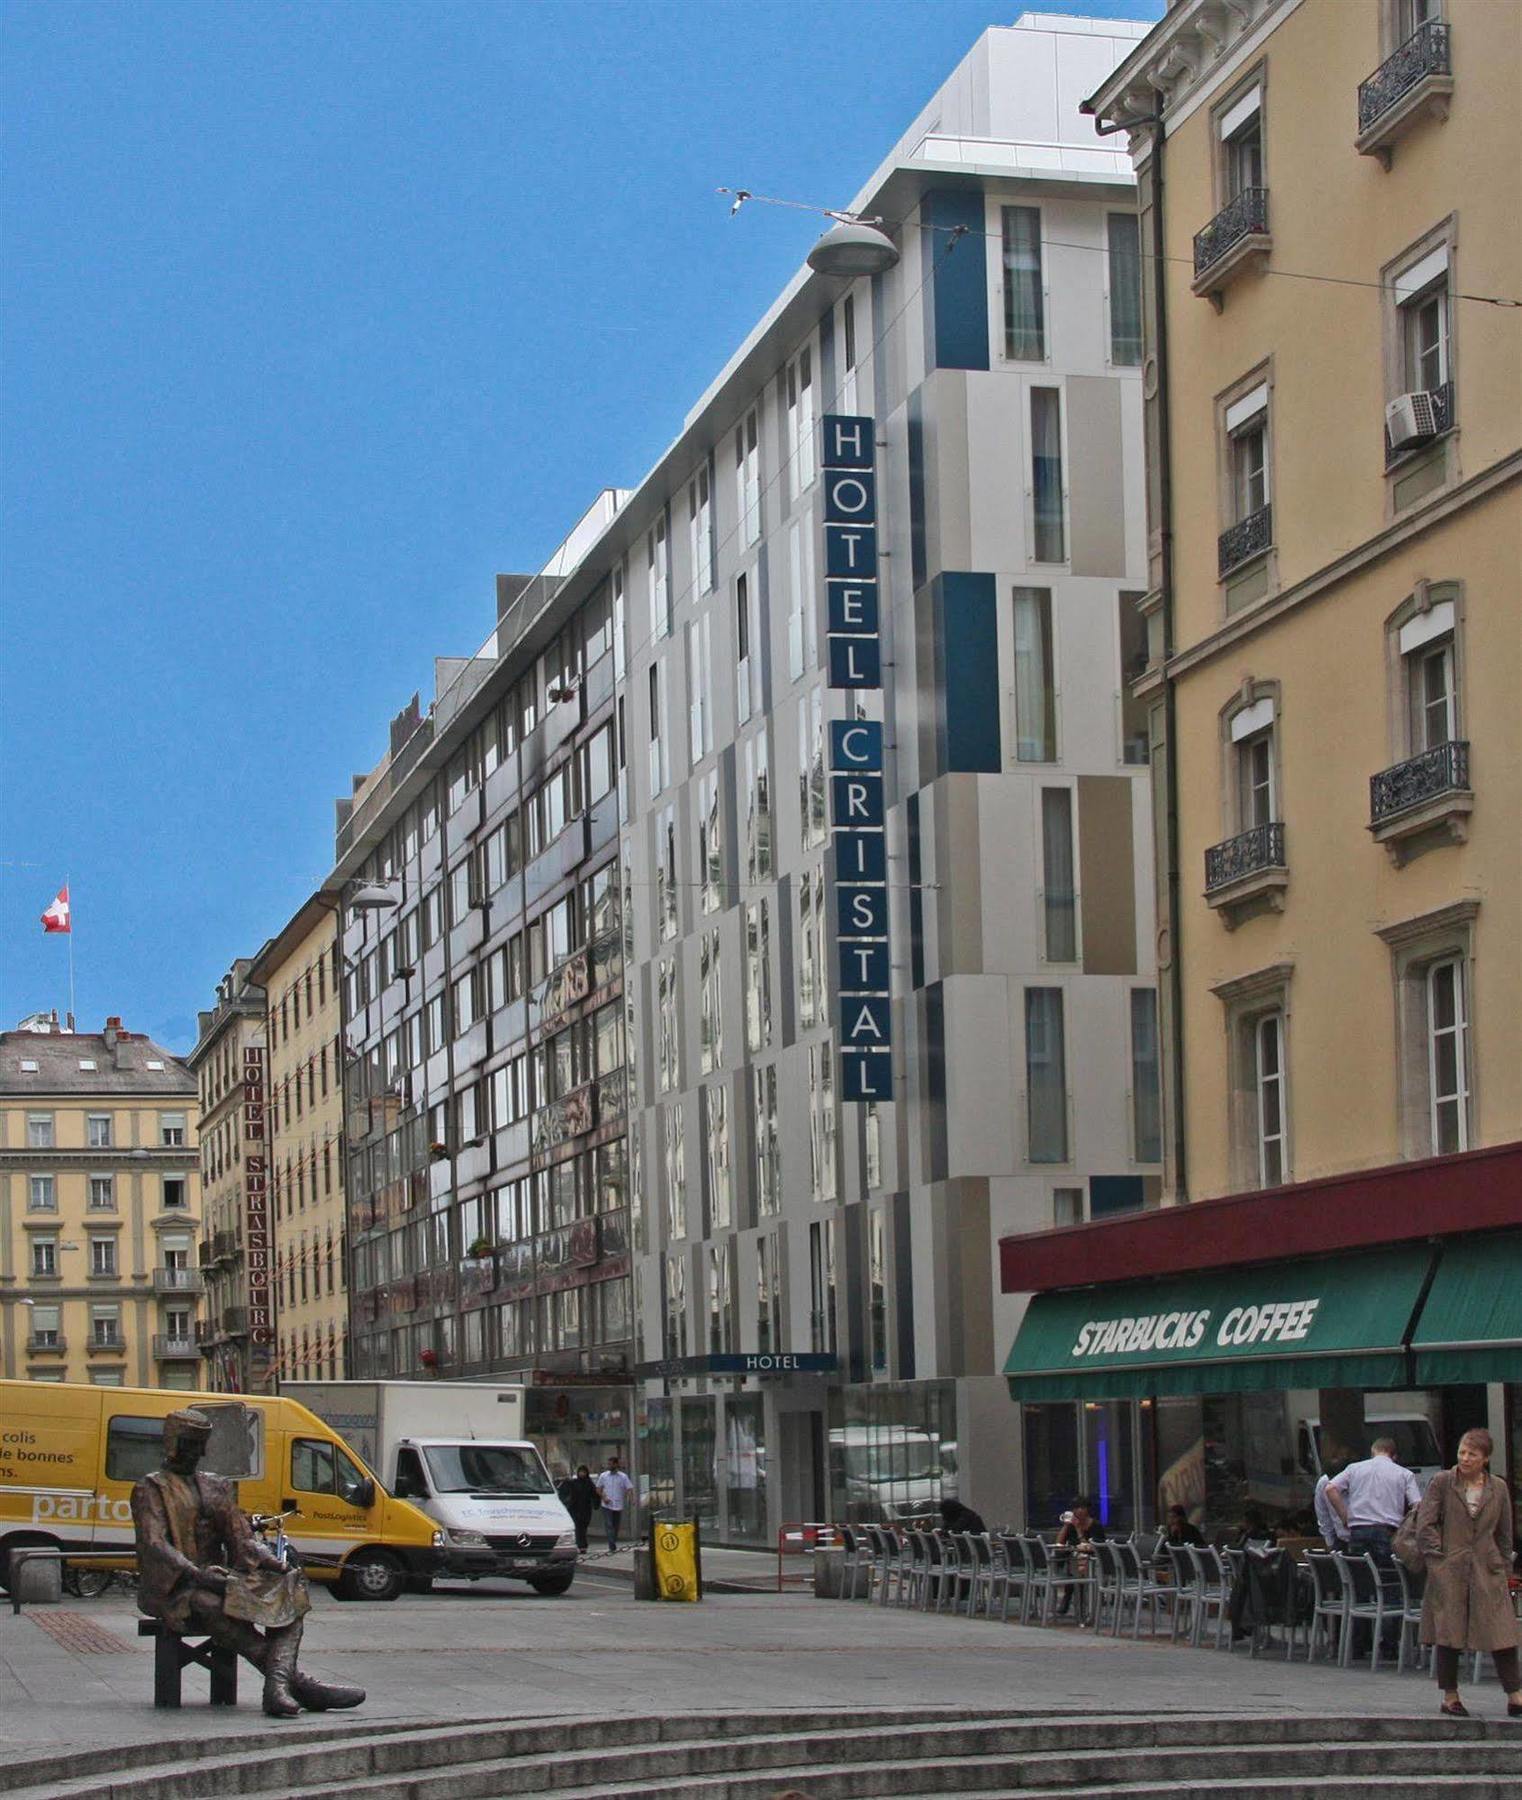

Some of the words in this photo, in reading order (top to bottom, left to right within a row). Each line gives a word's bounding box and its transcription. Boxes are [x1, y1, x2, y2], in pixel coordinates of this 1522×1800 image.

[832, 423, 868, 679] HOTEL
[841, 728, 882, 1094] CRISTAL
[245, 1048, 262, 1140] HOTEL
[249, 1157, 268, 1344] STRASBOURG
[746, 1355, 800, 1370] HOTEL
[1072, 1309, 1211, 1357] STARBUCKS
[1217, 1298, 1320, 1347] COFFEE
[2, 1431, 37, 1444] colis
[17, 1448, 75, 1463] bonnes
